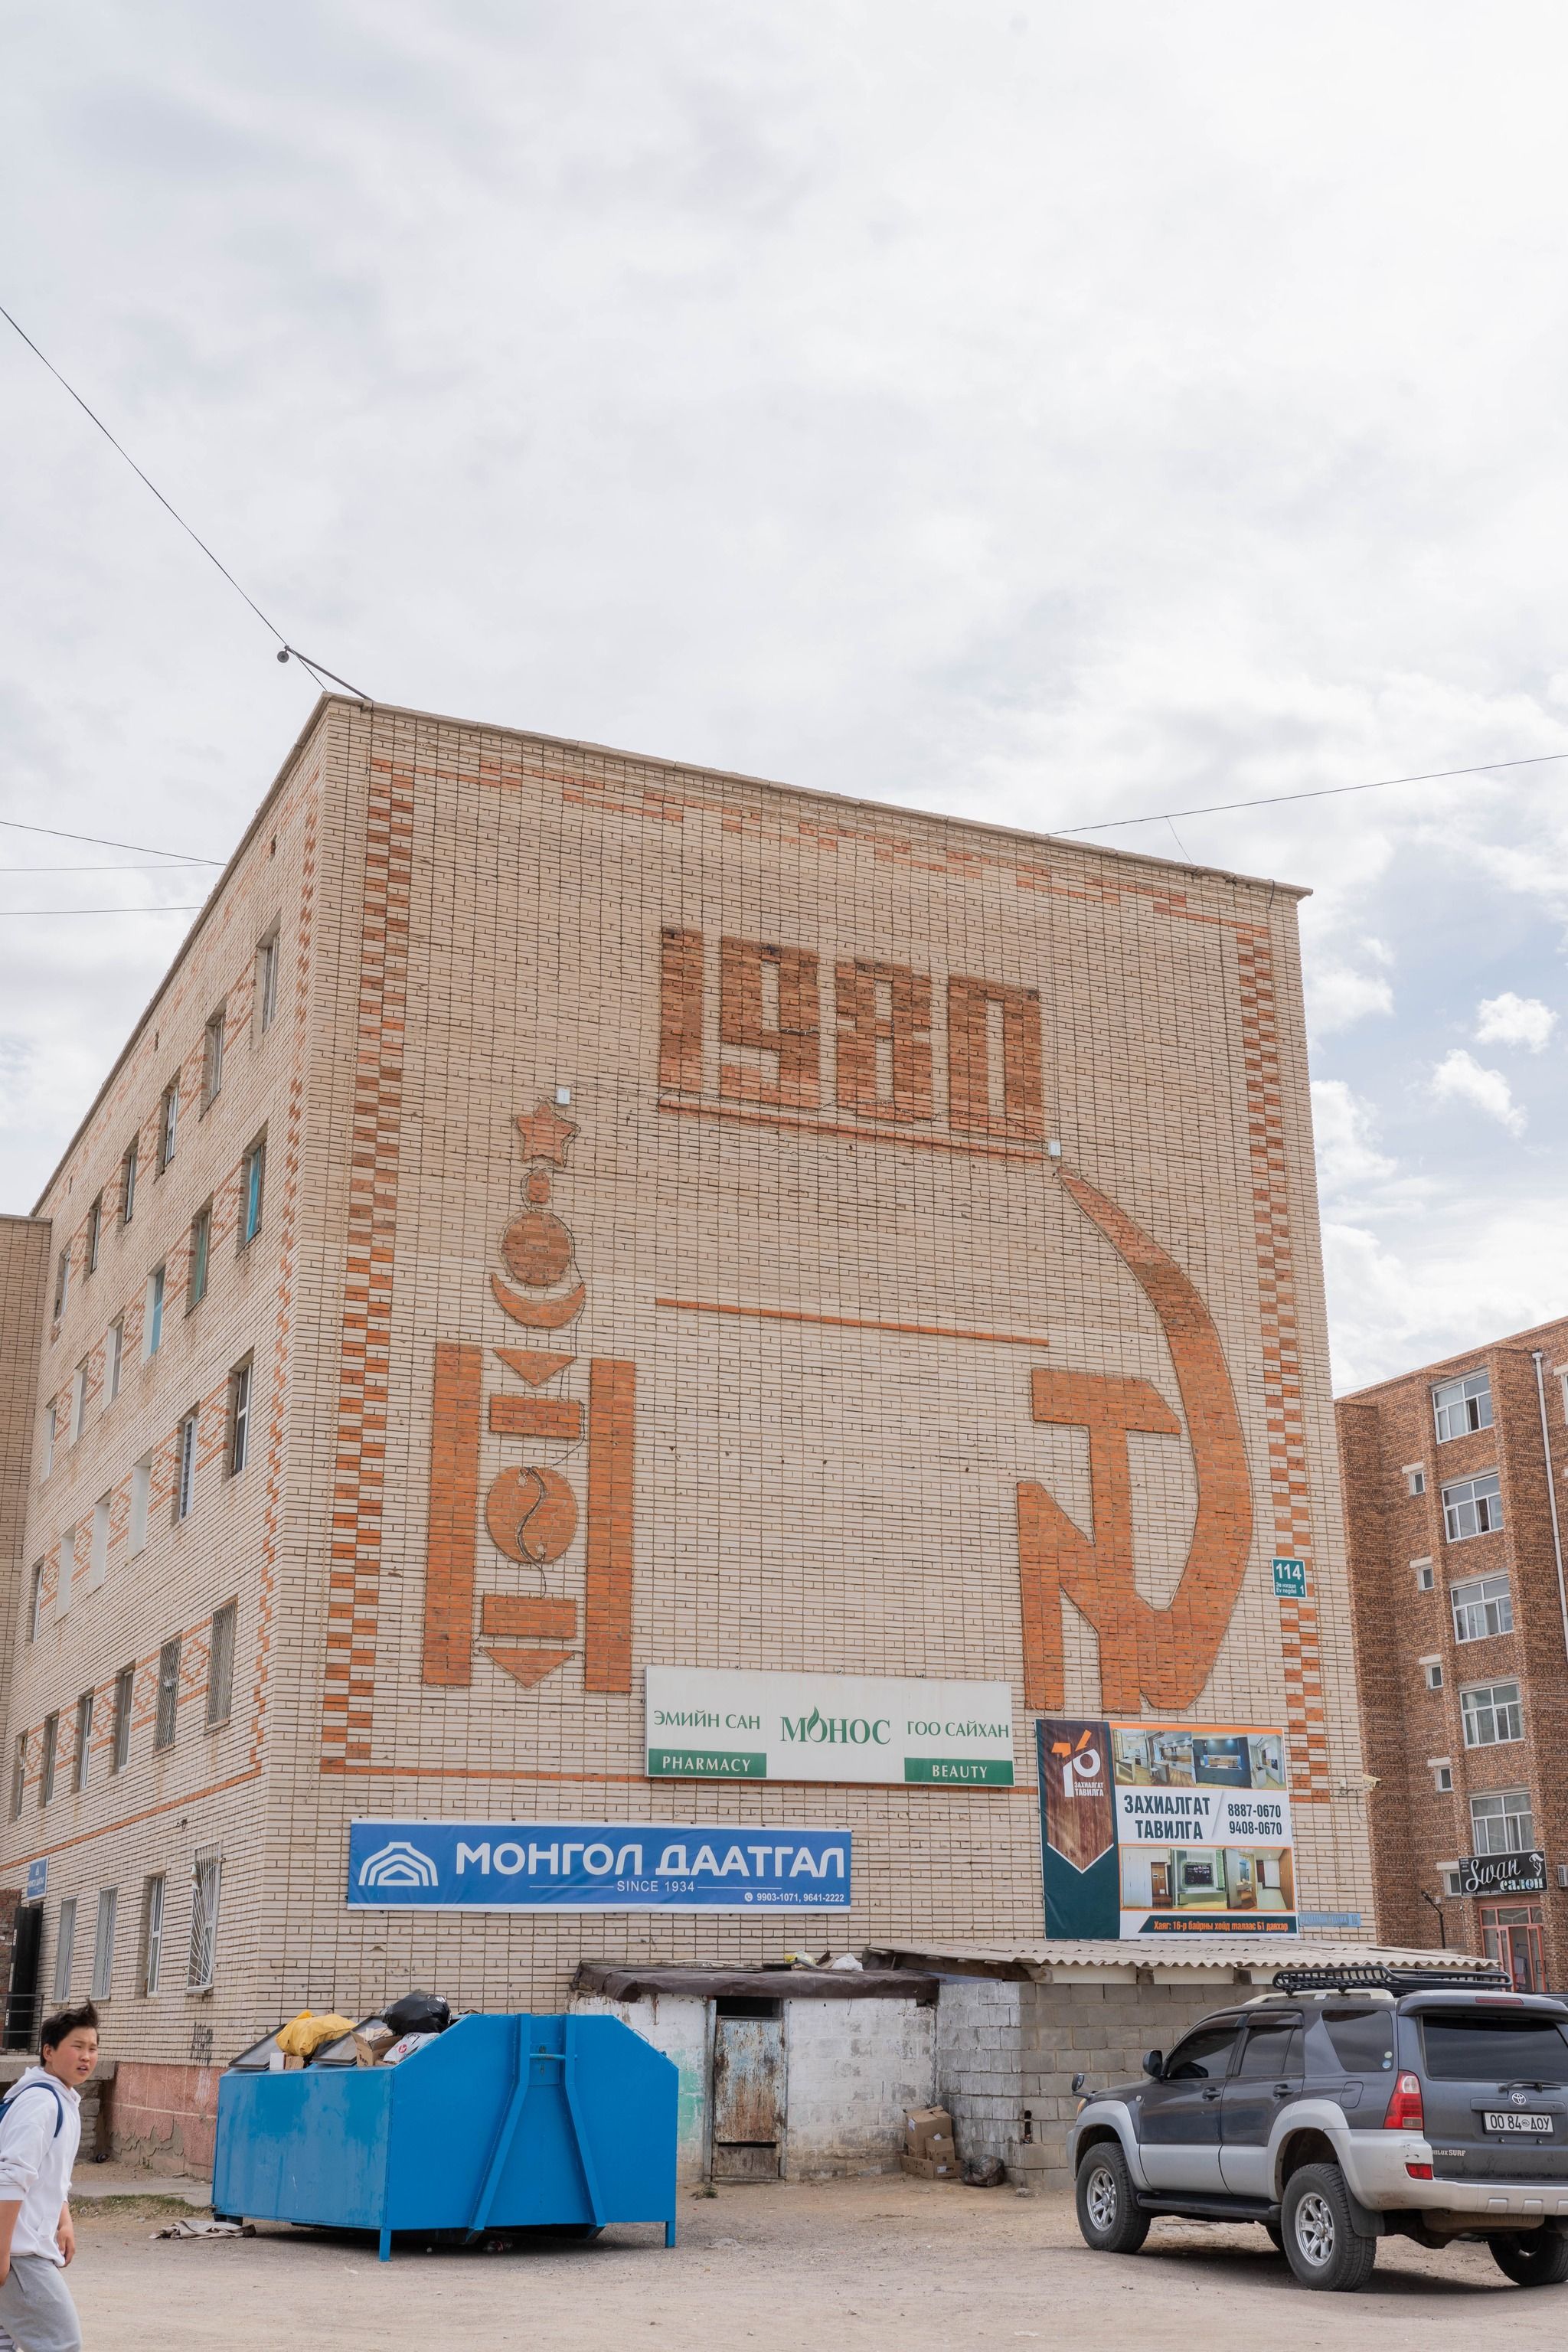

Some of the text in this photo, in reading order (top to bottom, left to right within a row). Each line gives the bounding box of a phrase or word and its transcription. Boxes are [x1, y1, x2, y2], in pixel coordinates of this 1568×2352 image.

[1276, 1563, 1302, 1580] 114
[1300, 1585, 1305, 1595] 1
[654, 1710, 760, 1730] ЭМИЙН САН
[779, 1707, 891, 1745] МОНОС
[907, 1720, 1009, 1738] ГОО САЙХАН
[662, 1756, 751, 1772] PHARMACY
[932, 1765, 988, 1779] BEAUTY
[1075, 1788, 1104, 1797] ТАВИЛГА
[1124, 1795, 1210, 1815] ЗАХИАЛГАТ
[1227, 1803, 1282, 1818] 8887-0670
[1135, 1819, 1203, 1839] ТАВИЛГА
[1229, 1821, 1282, 1835] 9408-0670
[456, 1842, 844, 1878] МОНГОЛ ДААТГАЛ
[1465, 1858, 1521, 1892] Swan
[617, 1880, 694, 1893] SINCE 1934
[1500, 1877, 1544, 1891] салон
[756, 1892, 844, 1903] 9903-1071, 9641-2222
[1154, 1921, 1171, 1930] Хаяг:
[1173, 1921, 1187, 1932] 16-р
[1188, 1920, 1214, 1932] байрны
[1215, 1921, 1230, 1932] хойд
[1266, 1922, 1288, 1932] давхар
[1508, 2115, 1521, 2130] 84
